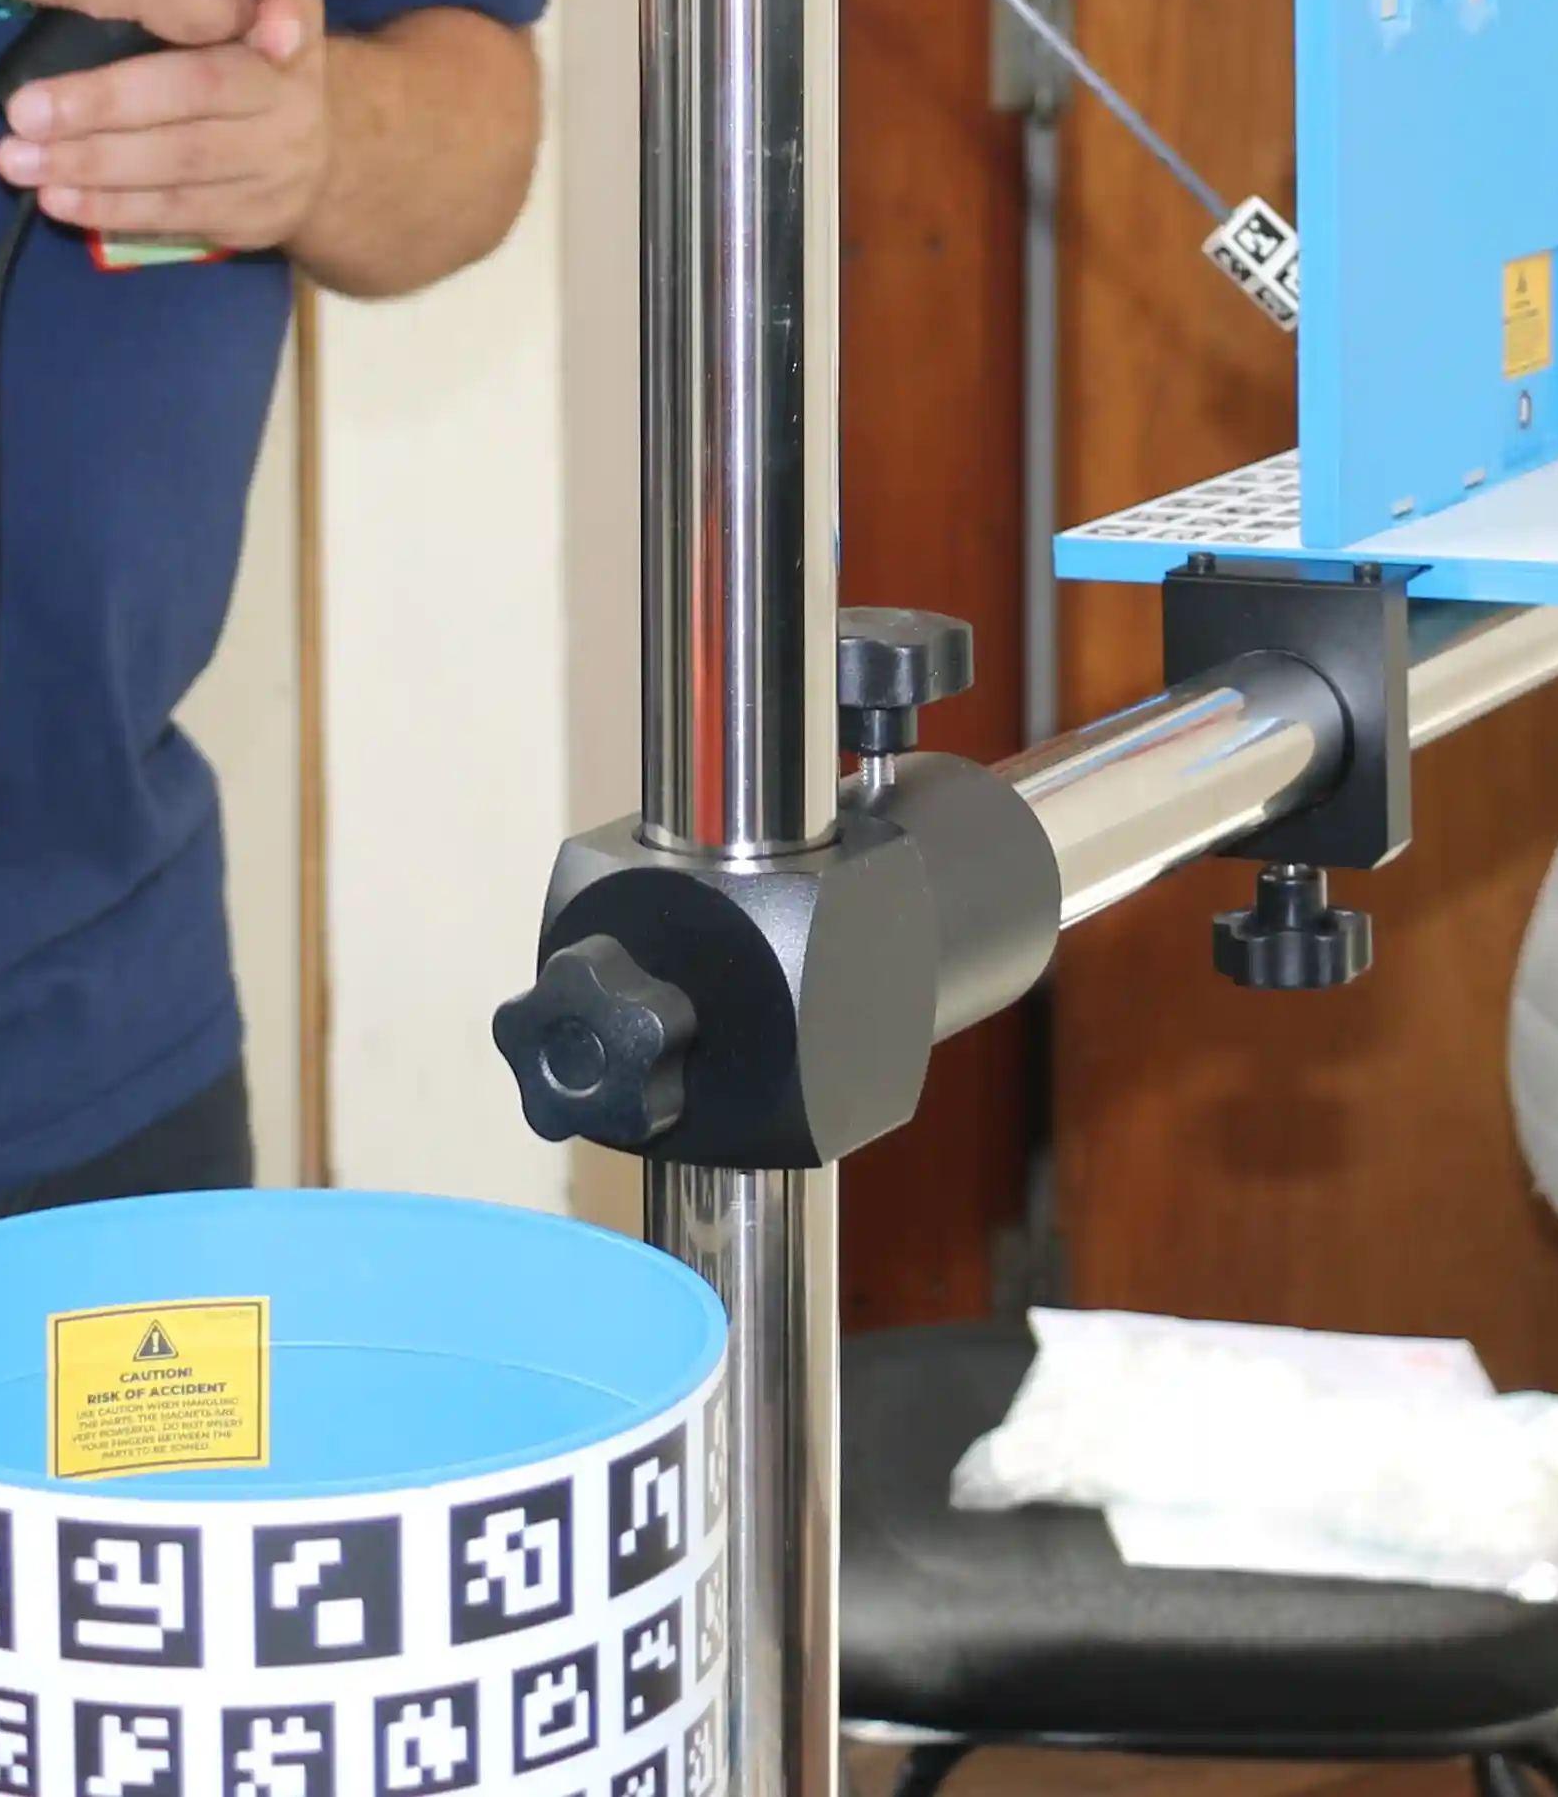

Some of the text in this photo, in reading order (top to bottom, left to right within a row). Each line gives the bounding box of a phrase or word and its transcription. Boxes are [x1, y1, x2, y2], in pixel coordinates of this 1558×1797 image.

[119, 1367, 192, 1384] CAUTION!
[87, 1382, 227, 1405] RISK OF ACCIDENT
[79, 1420, 98, 1430] THE
[137, 1413, 156, 1423] THE
[161, 1409, 211, 1420] MAGNETS
[214, 1407, 235, 1416] ARE
[97, 1404, 143, 1416] CAUTION
[147, 1400, 179, 1411] WHEN
[72, 1432, 96, 1443] VERY
[163, 1422, 178, 1431] DO
[181, 1420, 204, 1429] NOT
[81, 1430, 232, 1451] YOUR FINGERS BETWEEN THE
[136, 1447, 151, 1456] TO
[153, 1445, 167, 1454] BE
